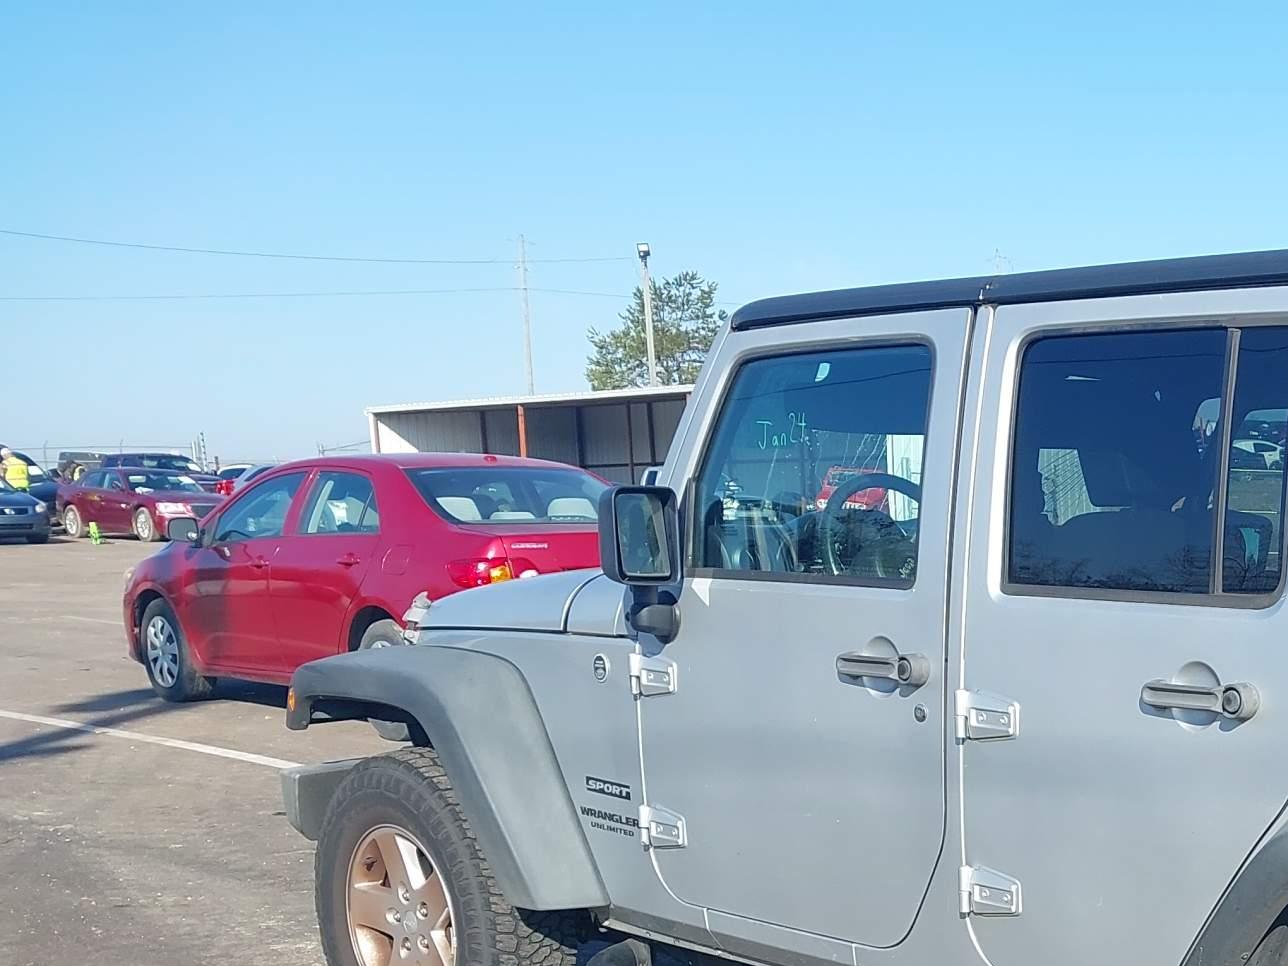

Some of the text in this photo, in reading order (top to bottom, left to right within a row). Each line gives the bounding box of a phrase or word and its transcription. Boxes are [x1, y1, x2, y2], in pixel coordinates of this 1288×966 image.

[756, 420, 787, 450] Jan
[587, 779, 631, 798] SPORT
[580, 806, 640, 829] WRANGLER
[591, 821, 635, 837] UNLIMITED
